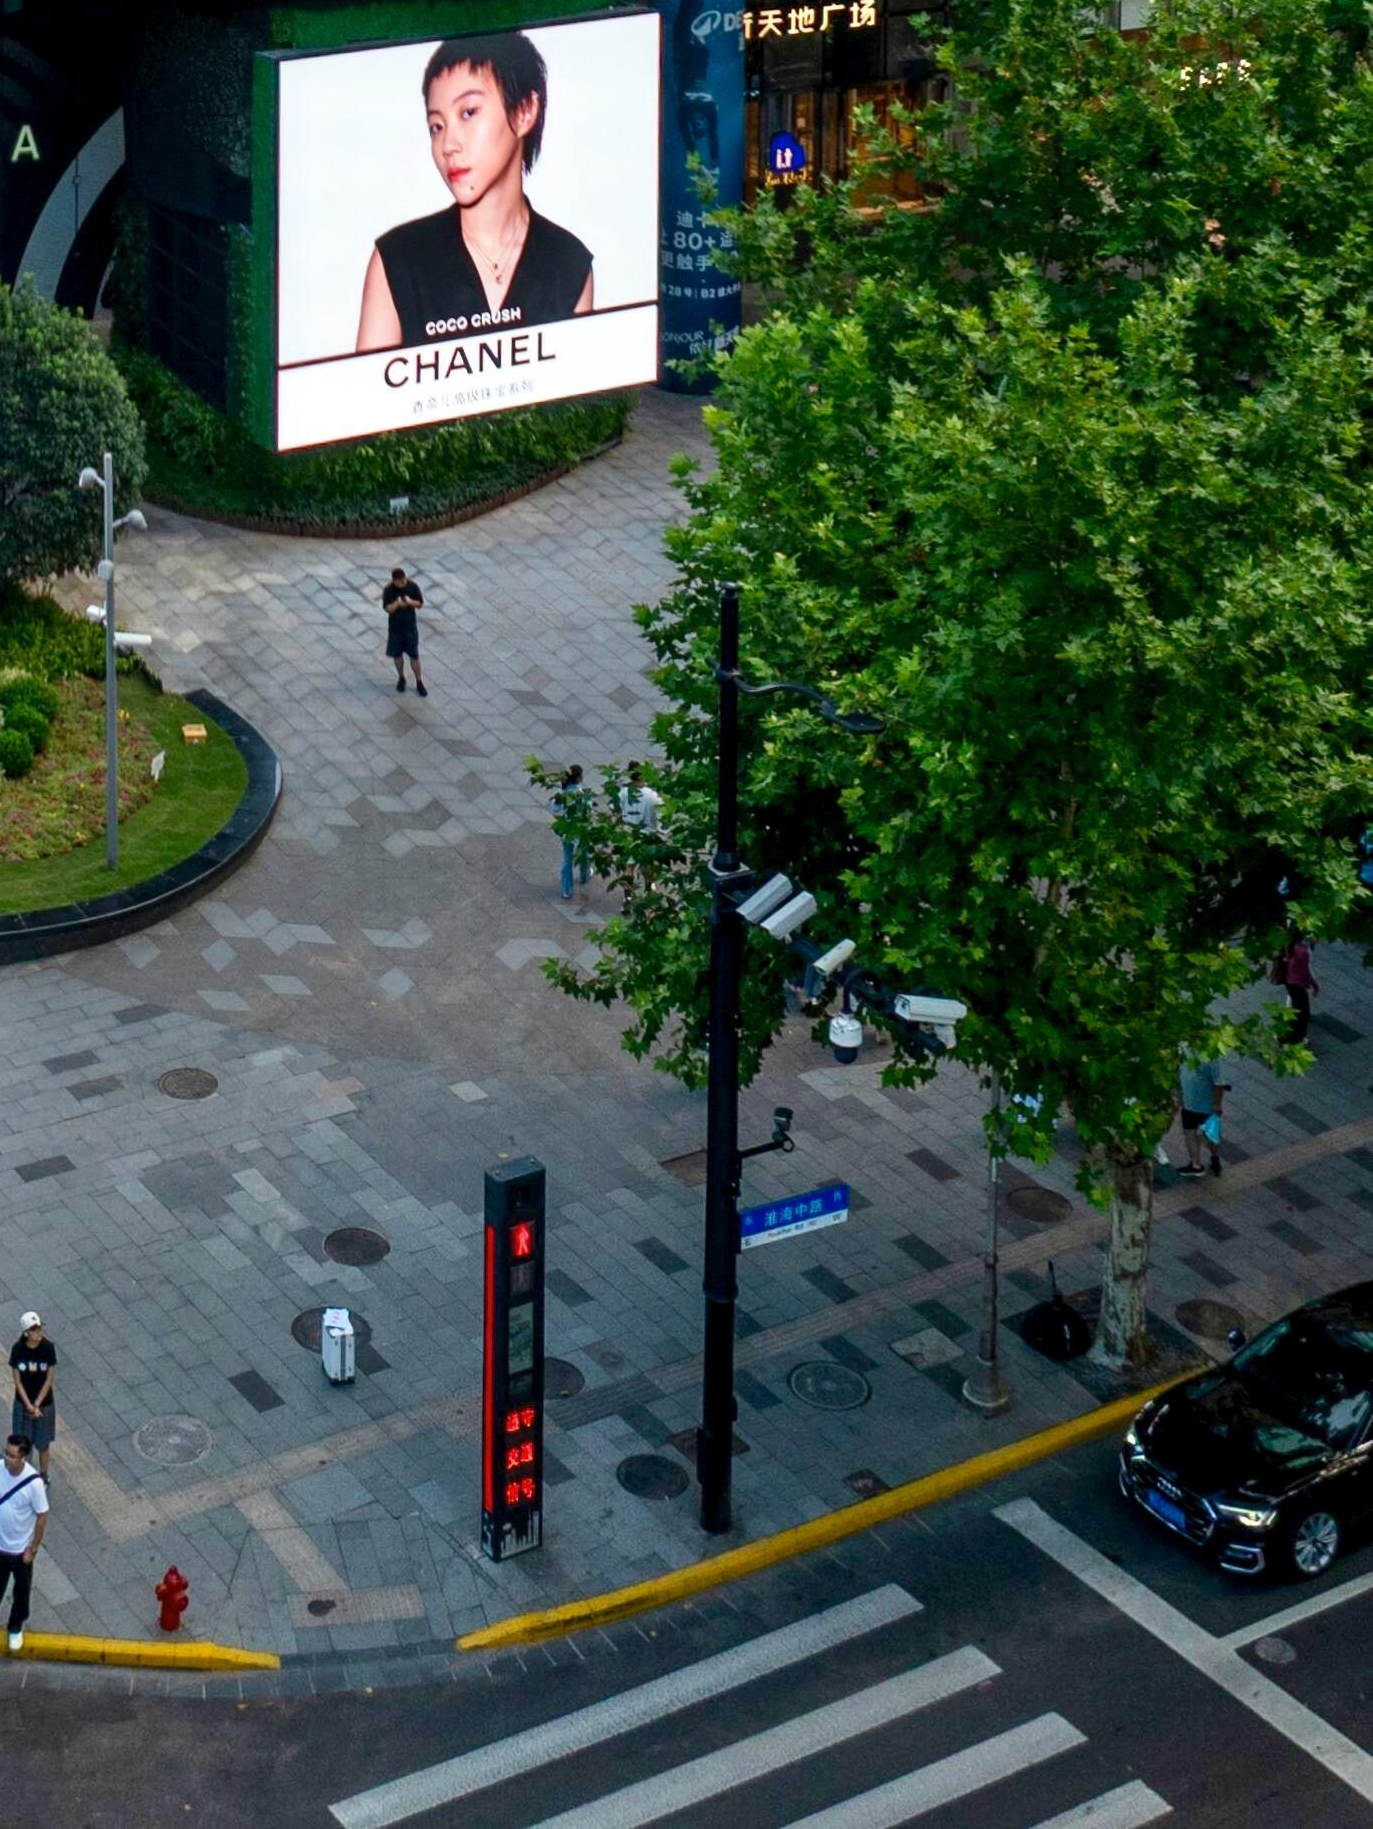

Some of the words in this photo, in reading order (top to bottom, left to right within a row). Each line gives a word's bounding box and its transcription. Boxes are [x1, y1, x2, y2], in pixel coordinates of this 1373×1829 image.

[426, 318, 468, 336] COCO
[471, 307, 521, 328] CRUSH
[383, 331, 557, 389] CHANEL
